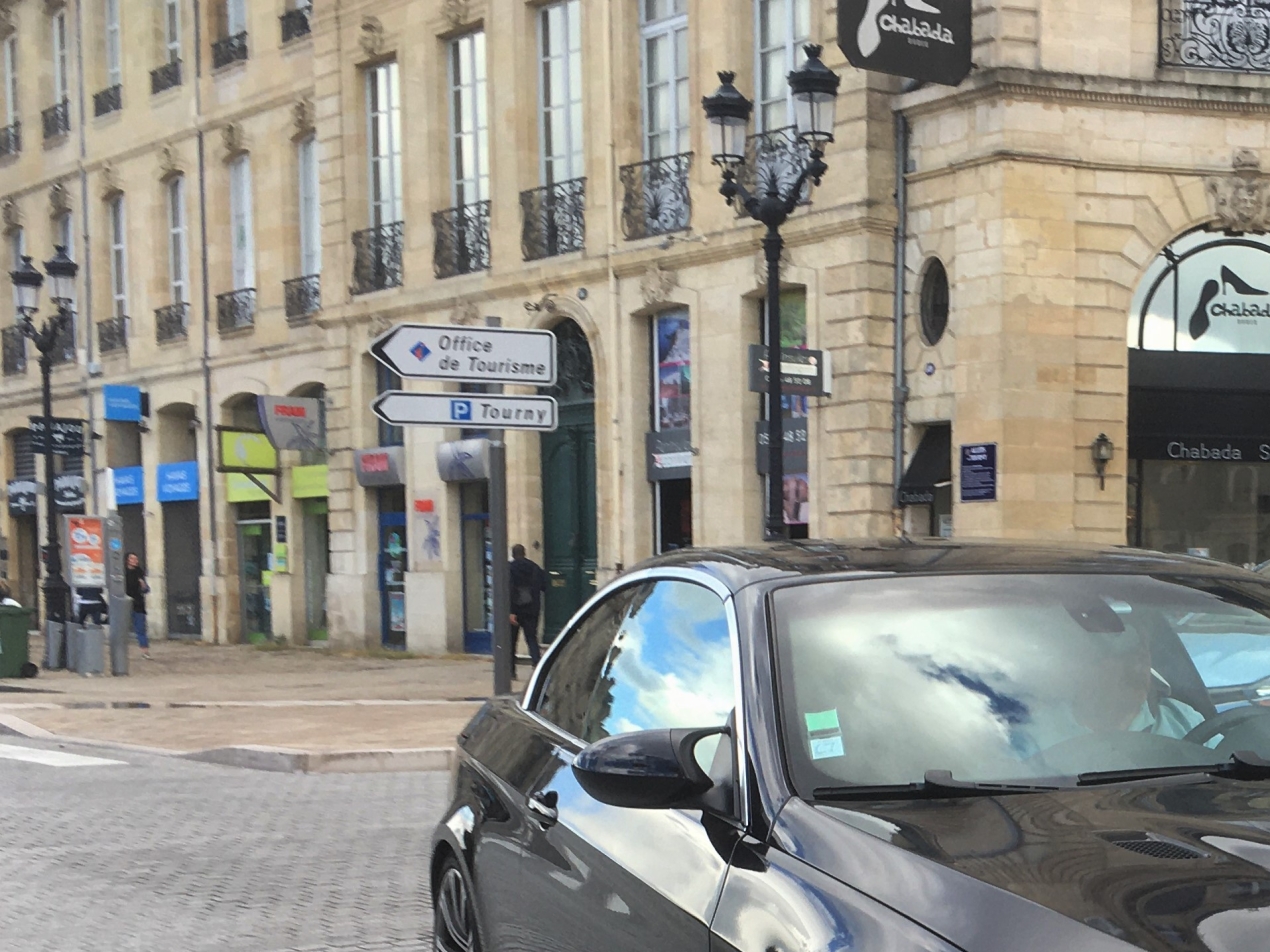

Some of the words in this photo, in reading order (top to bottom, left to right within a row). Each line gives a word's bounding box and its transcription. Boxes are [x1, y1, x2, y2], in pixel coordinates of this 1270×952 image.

[879, 14, 955, 45] Chabada
[438, 335, 493, 353] Office
[438, 356, 460, 371] de
[467, 356, 546, 376] Tourisme
[454, 403, 468, 419] P
[481, 403, 548, 424] Tourny
[1167, 441, 1242, 460] Chabada
